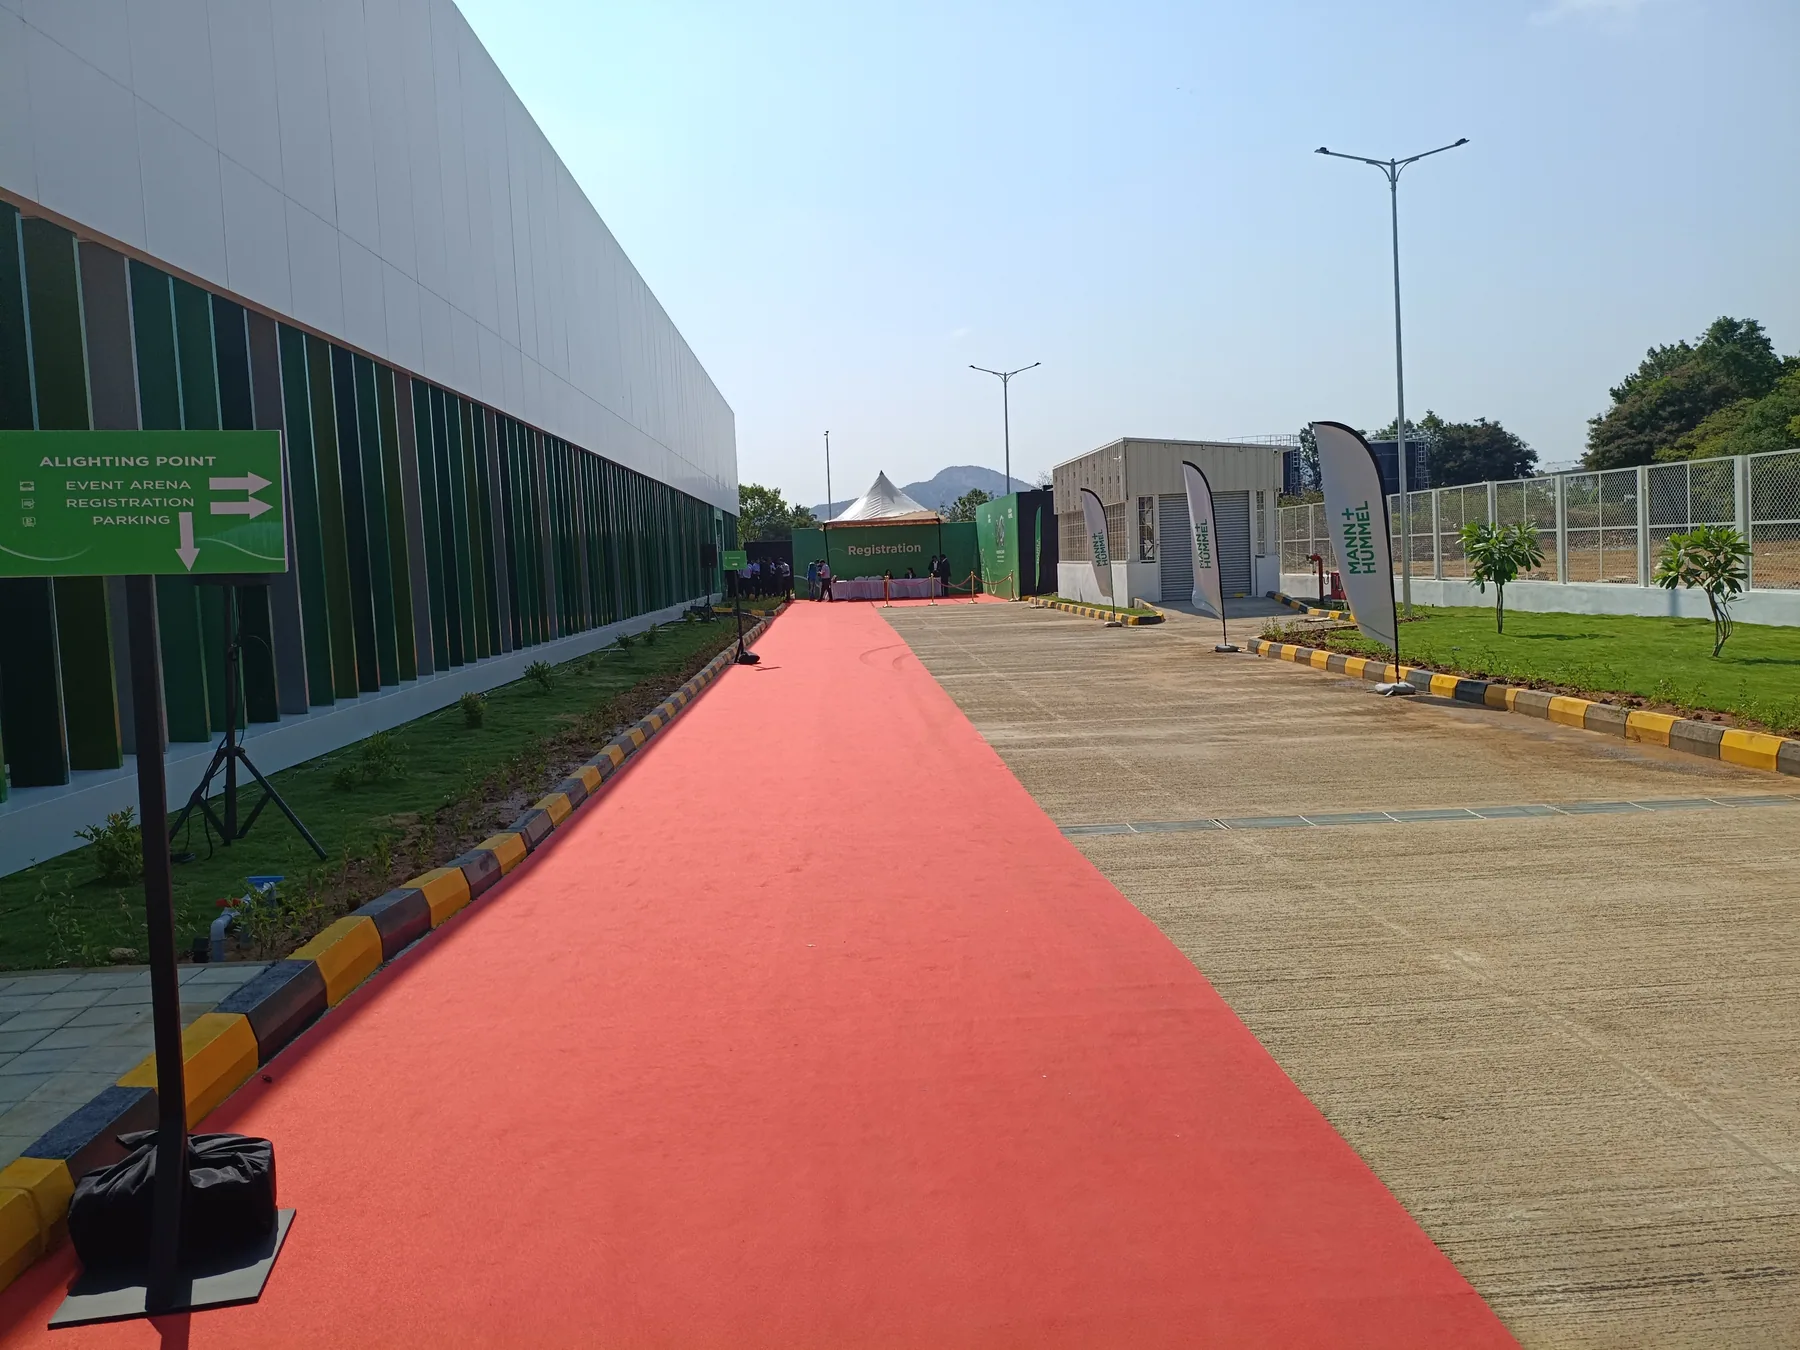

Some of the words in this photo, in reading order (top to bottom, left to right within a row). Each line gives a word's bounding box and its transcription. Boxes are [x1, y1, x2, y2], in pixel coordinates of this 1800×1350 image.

[40, 456, 149, 467] ALIGHTING
[156, 455, 216, 466] POINT
[66, 480, 124, 490] EVENT
[130, 480, 191, 490] ARENA
[66, 498, 194, 508] REGISTRATION
[93, 515, 170, 525] PARKING
[1200, 518, 1212, 569] HUMMEL
[1342, 508, 1361, 574] MANN+
[1355, 501, 1376, 574] HUMMEL
[848, 543, 921, 557] Registration
[1098, 529, 1108, 566] HUMMEL
